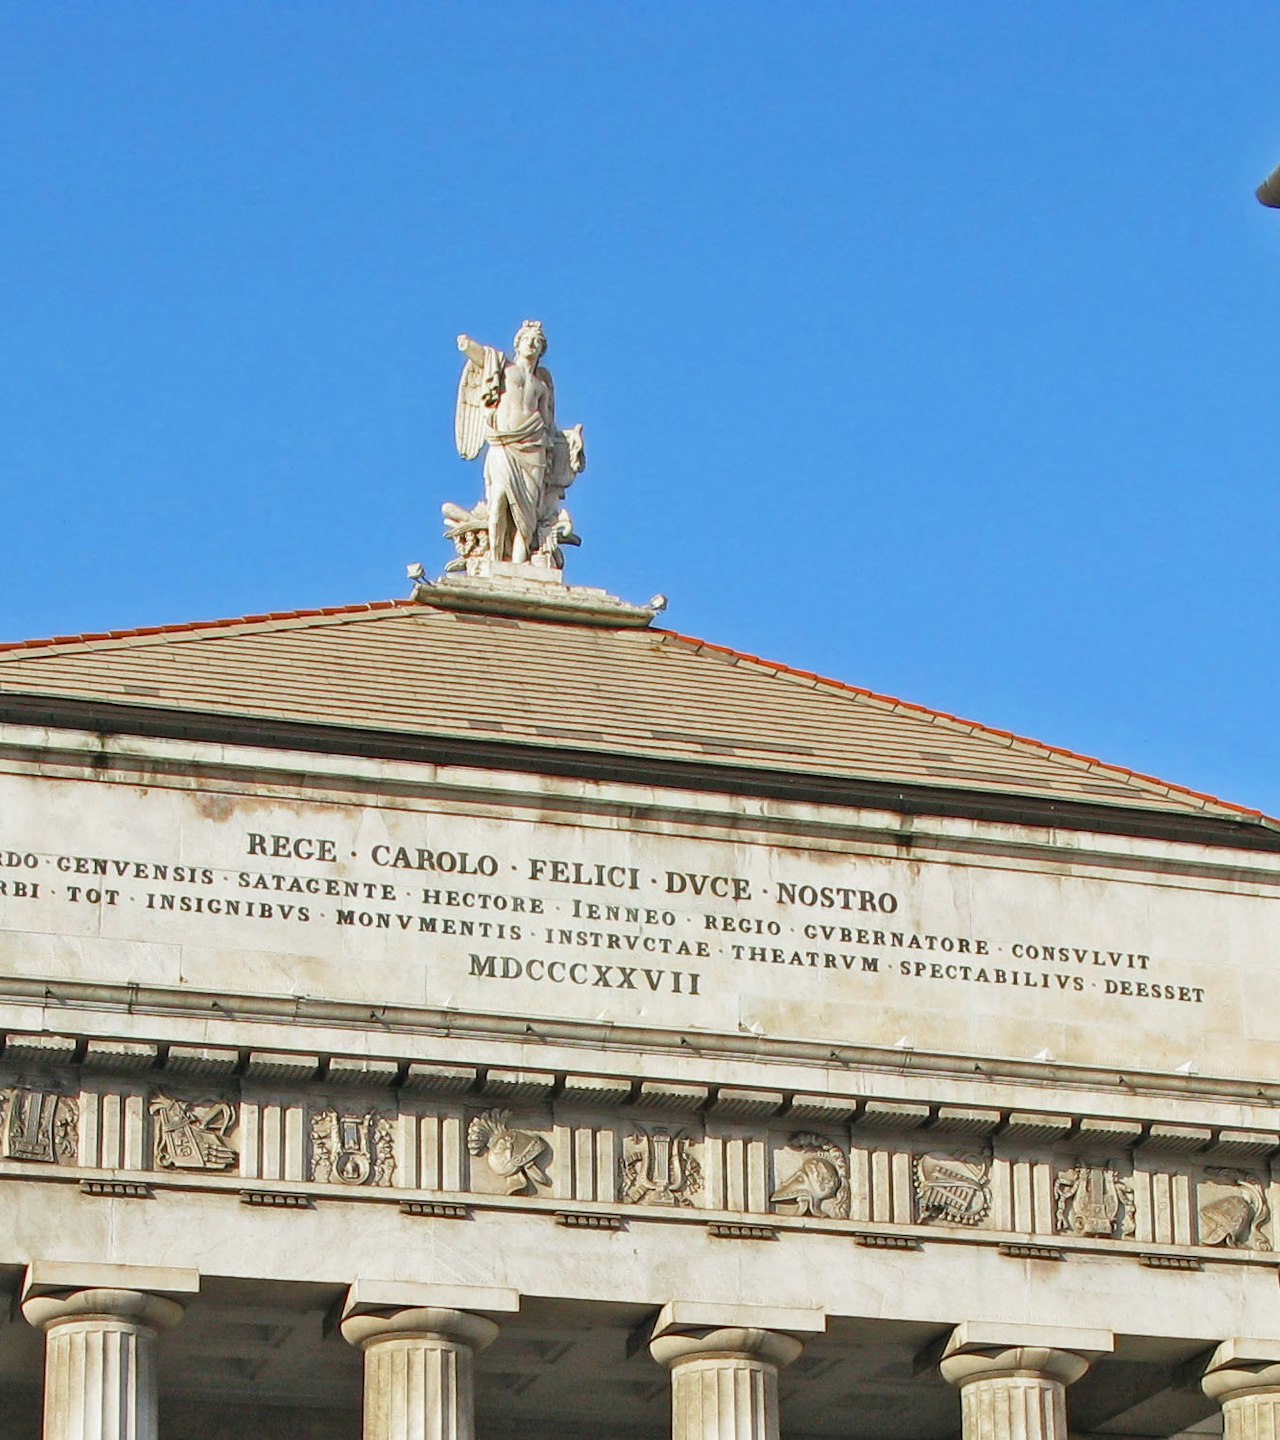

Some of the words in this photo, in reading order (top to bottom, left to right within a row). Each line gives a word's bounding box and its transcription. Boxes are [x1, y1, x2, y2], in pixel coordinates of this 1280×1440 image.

[56, 855, 214, 885] GENVENSIS
[238, 871, 397, 901] SATAGENTE
[421, 888, 545, 915] HECTORE
[571, 898, 676, 927] IENNEO
[703, 914, 781, 936] REGIO
[803, 923, 990, 956] GVBERNATORE
[1011, 943, 1150, 970] CONSVLVIT
[246, 832, 337, 863] REGE
[370, 844, 499, 877] CAROLO
[527, 858, 641, 891] FELICI
[664, 870, 752, 904] DVCE
[775, 881, 898, 914] NOSTRO
[66, 885, 120, 906] TOT
[146, 893, 310, 923] INSIGNIBVS
[335, 908, 522, 941] MONVMENTIS
[544, 928, 711, 958] INSTRVCTAE
[731, 944, 880, 973] THEATRVM
[899, 960, 1084, 992] SPECTABILIVS
[1104, 978, 1205, 1003] DEESSET
[467, 953, 701, 996] MDCCCXXVII
